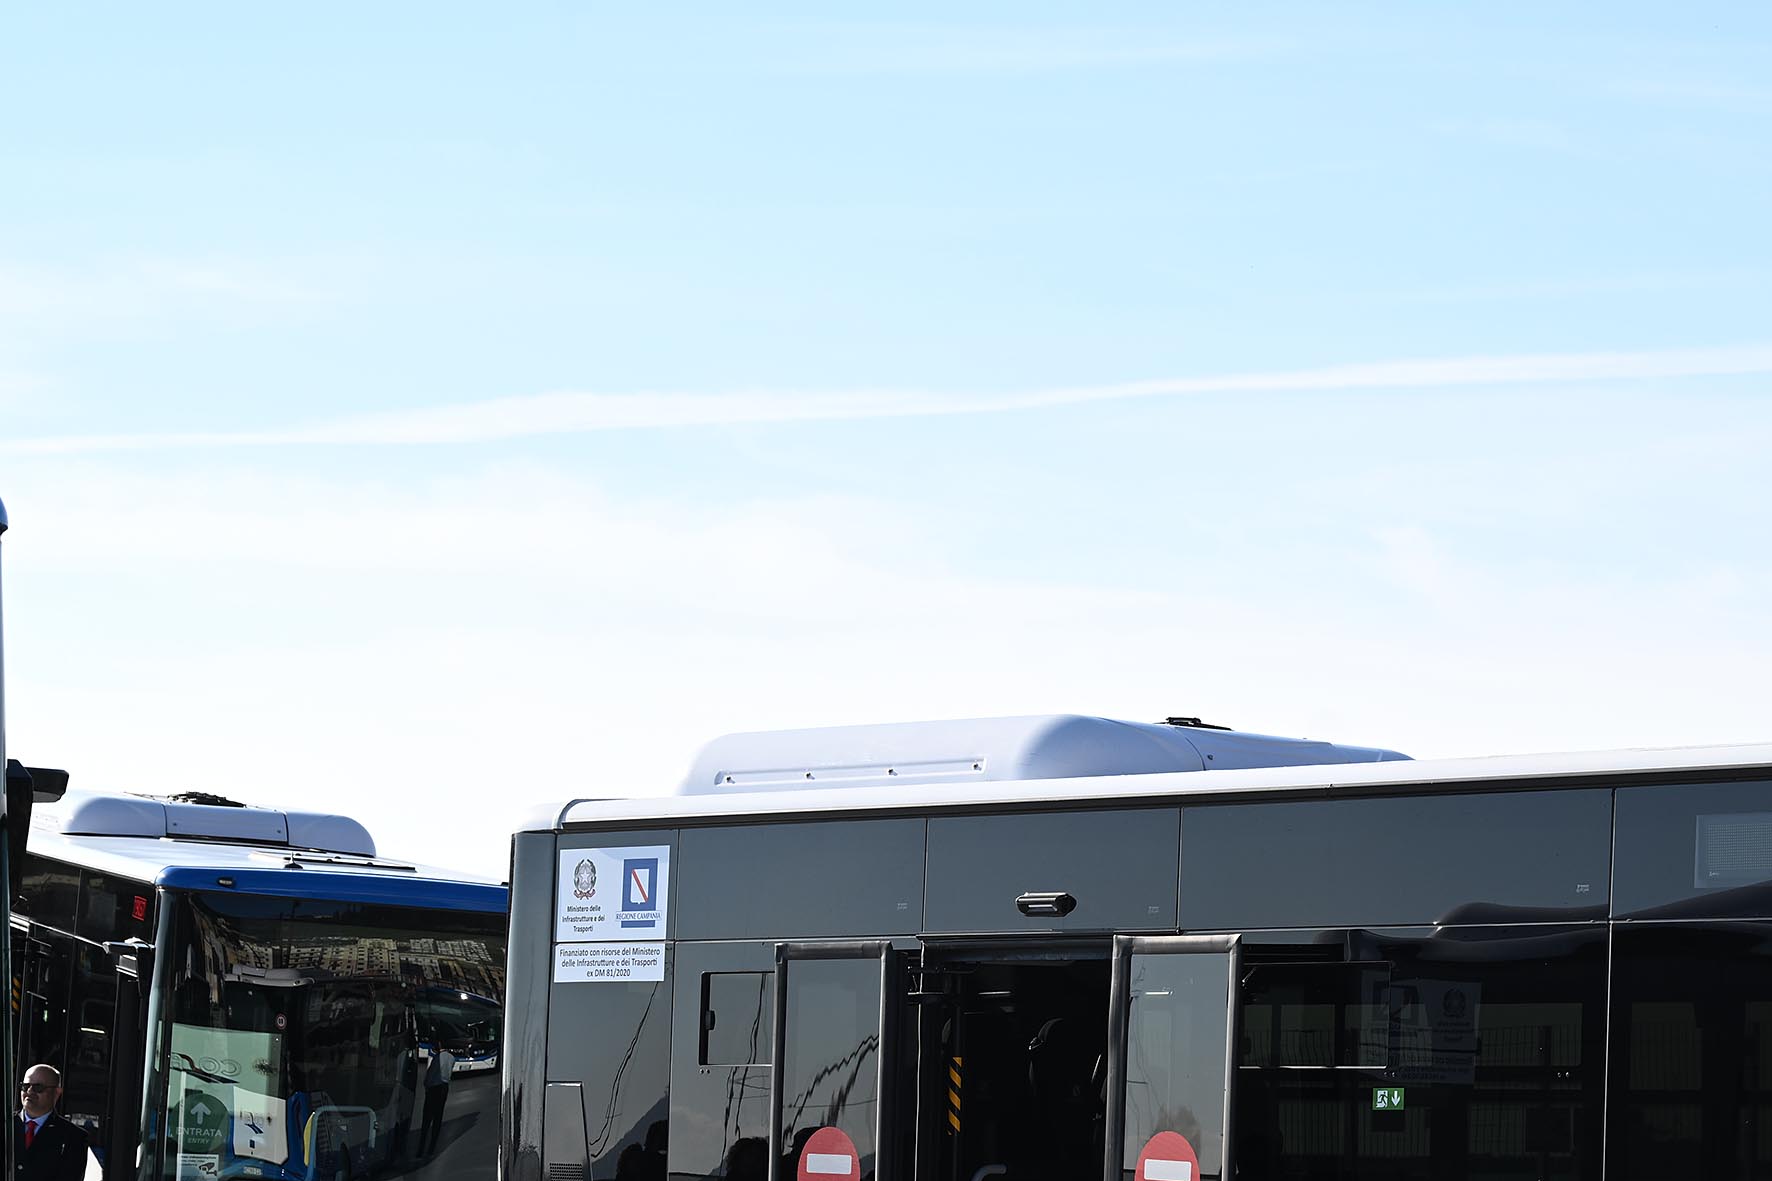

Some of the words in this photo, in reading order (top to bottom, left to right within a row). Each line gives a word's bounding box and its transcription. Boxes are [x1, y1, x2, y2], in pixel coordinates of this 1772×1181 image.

[567, 905, 589, 913] Ministero
[590, 904, 601, 912] delle
[562, 915, 594, 923] Infrastrutture
[616, 912, 637, 920] REGIONE
[573, 925, 593, 934] Trasporti
[560, 948, 588, 957] Finanziato
[601, 948, 620, 956] risorse
[622, 947, 631, 956] del
[632, 947, 661, 956] Ministero
[561, 959, 575, 968] delle
[577, 958, 615, 967] Infrastrutture
[621, 958, 631, 967] dei
[632, 957, 658, 968] Trasporti
[586, 970, 593, 978] ex
[594, 969, 606, 977] DM
[606, 968, 631, 979] 81/2020
[175, 1126, 223, 1138] ENTRATA
